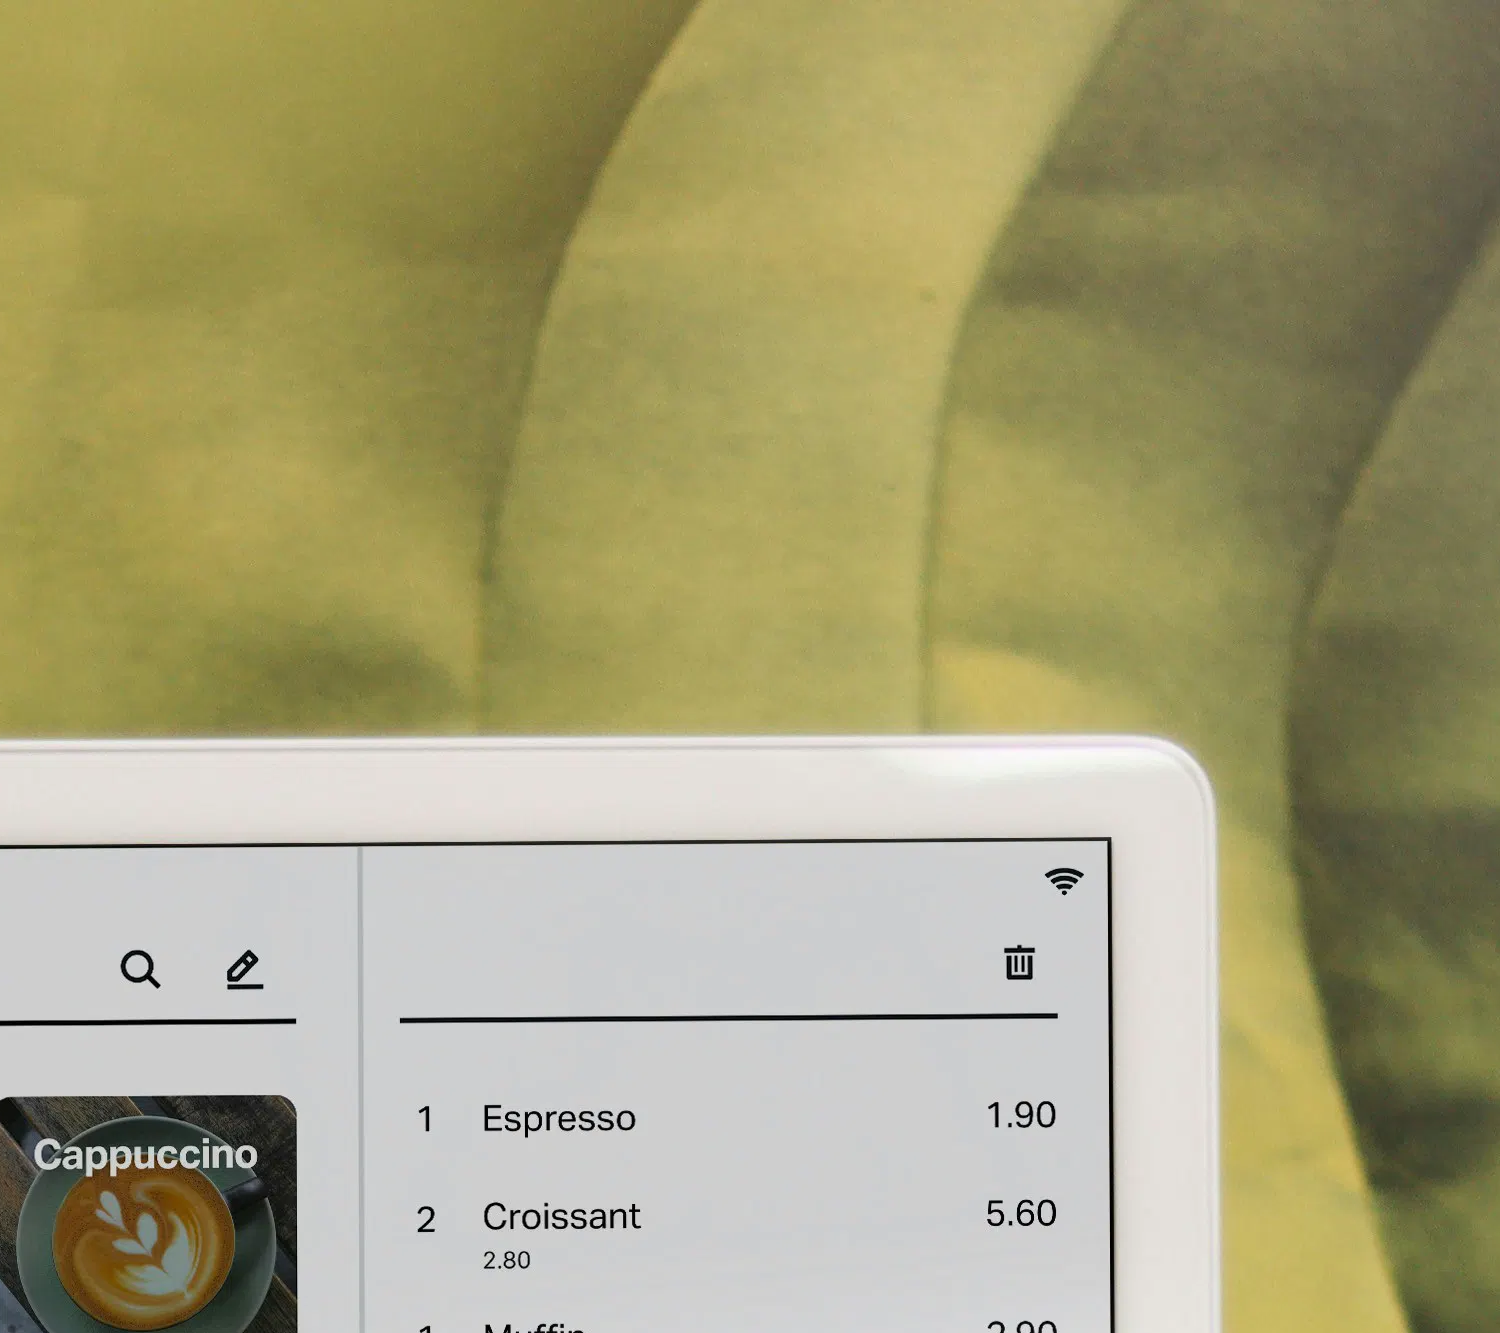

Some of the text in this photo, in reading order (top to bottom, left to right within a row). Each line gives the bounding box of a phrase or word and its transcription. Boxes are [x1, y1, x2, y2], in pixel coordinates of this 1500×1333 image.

[418, 1101, 1057, 1139] 1 Espresso 1.90
[34, 1138, 259, 1178] Cappuccino
[416, 1199, 1058, 1233] 2 Croissant 5.60
[483, 1250, 531, 1270] 2.80
